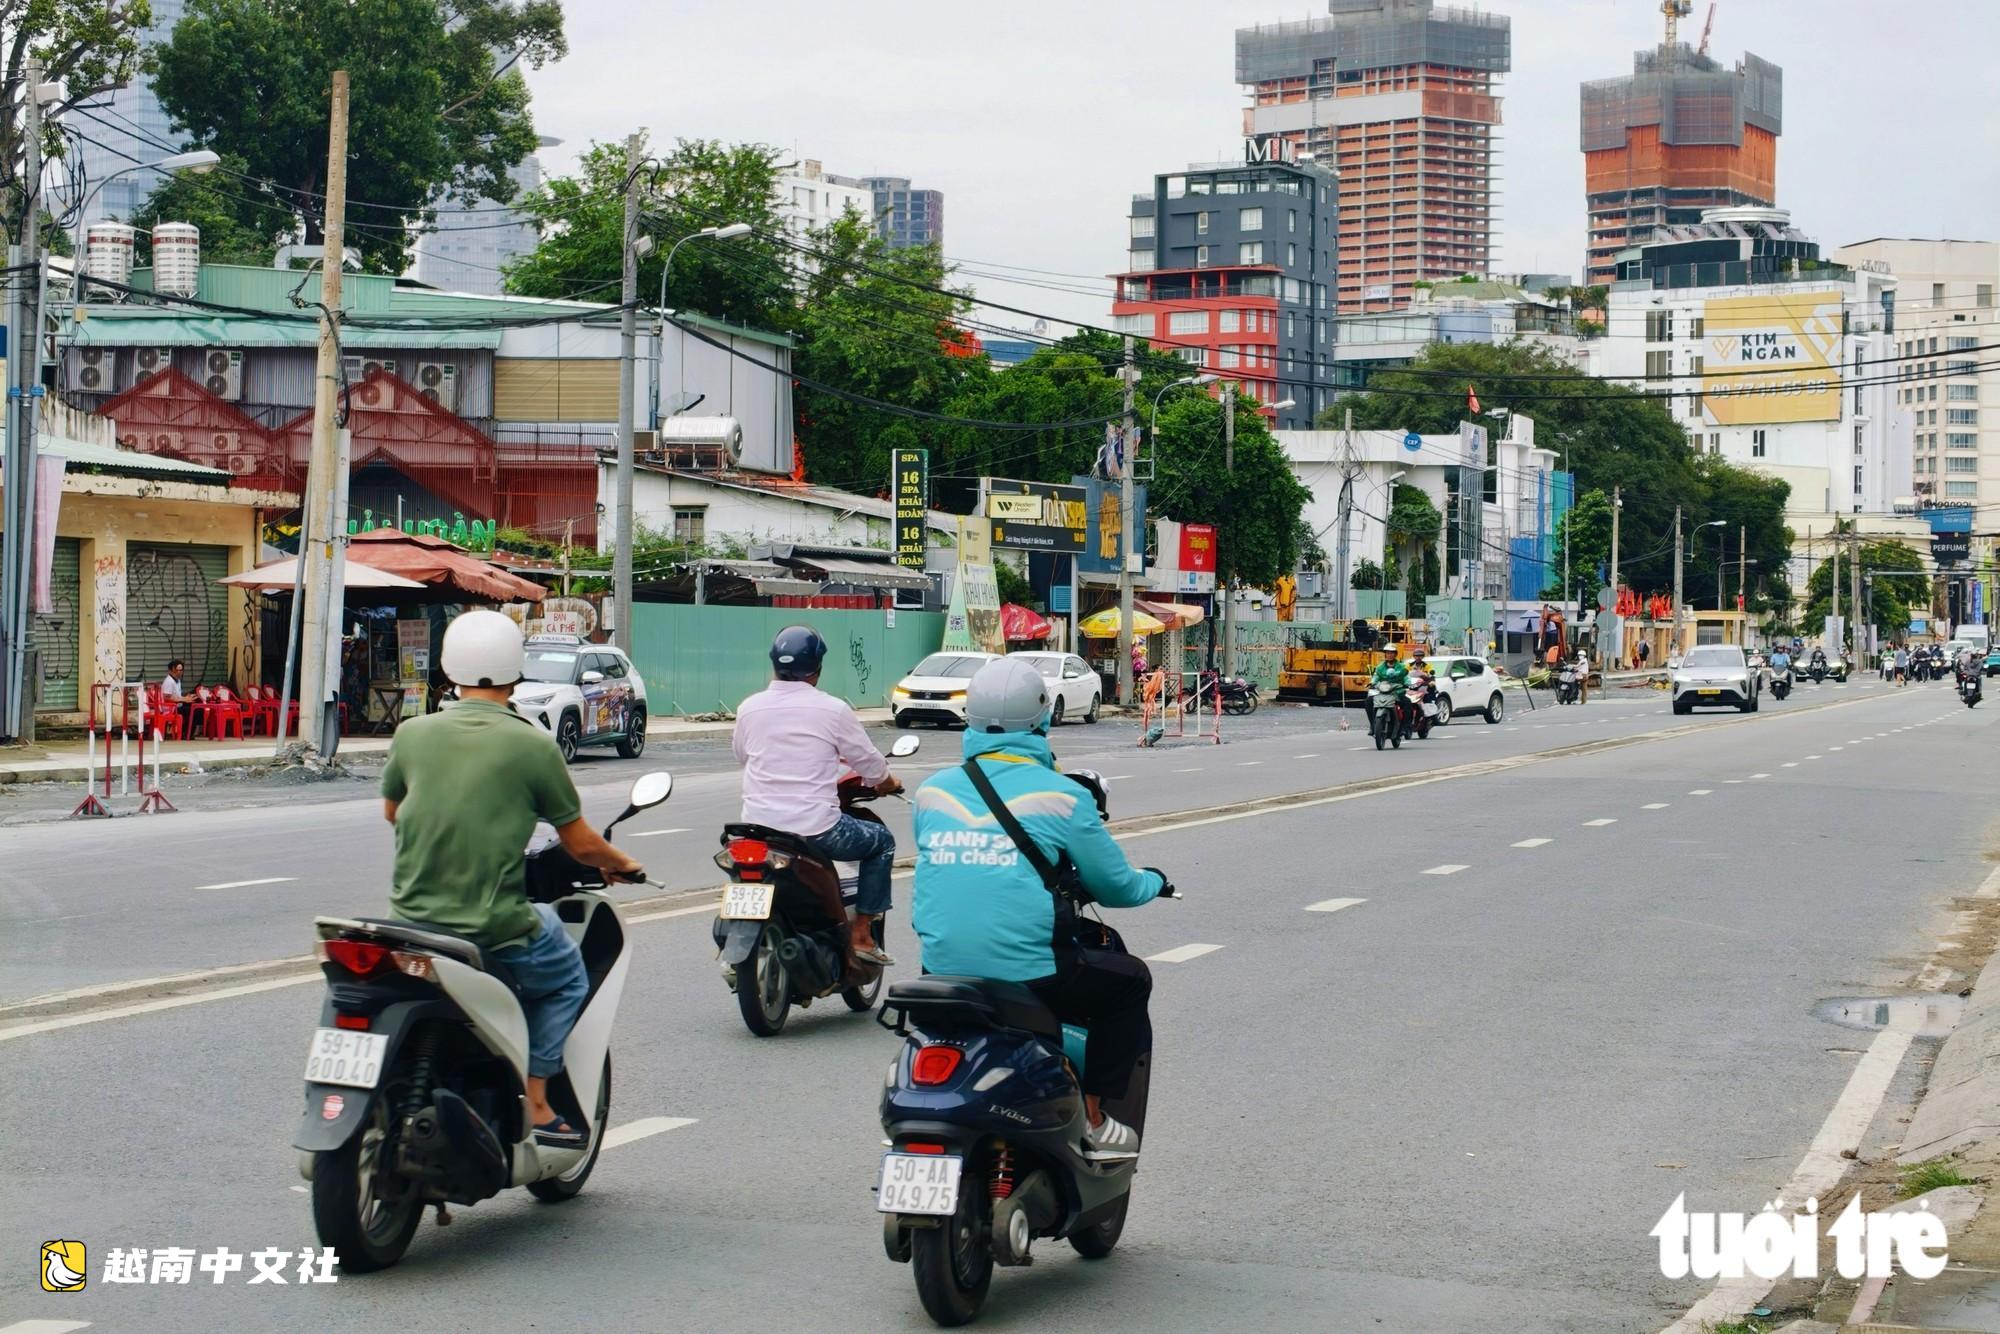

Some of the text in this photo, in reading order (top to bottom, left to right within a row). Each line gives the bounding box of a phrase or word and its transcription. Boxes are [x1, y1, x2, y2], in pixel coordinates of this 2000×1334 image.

[1741, 333, 1777, 346] KIM
[1741, 346, 1797, 360] NGAN
[901, 454, 919, 462] SPA
[902, 471, 919, 484] 16
[901, 486, 920, 494] SPA
[1065, 501, 1087, 529] SPA
[902, 527, 920, 540] 16
[1933, 544, 1967, 552] PERFUME
[928, 831, 988, 848] XANH
[929, 847, 956, 865] xin
[731, 886, 767, 902] 59-F2
[321, 1031, 374, 1059] 59-T1
[893, 1158, 949, 1184] 50-AA
[883, 1184, 953, 1211] 949.75
